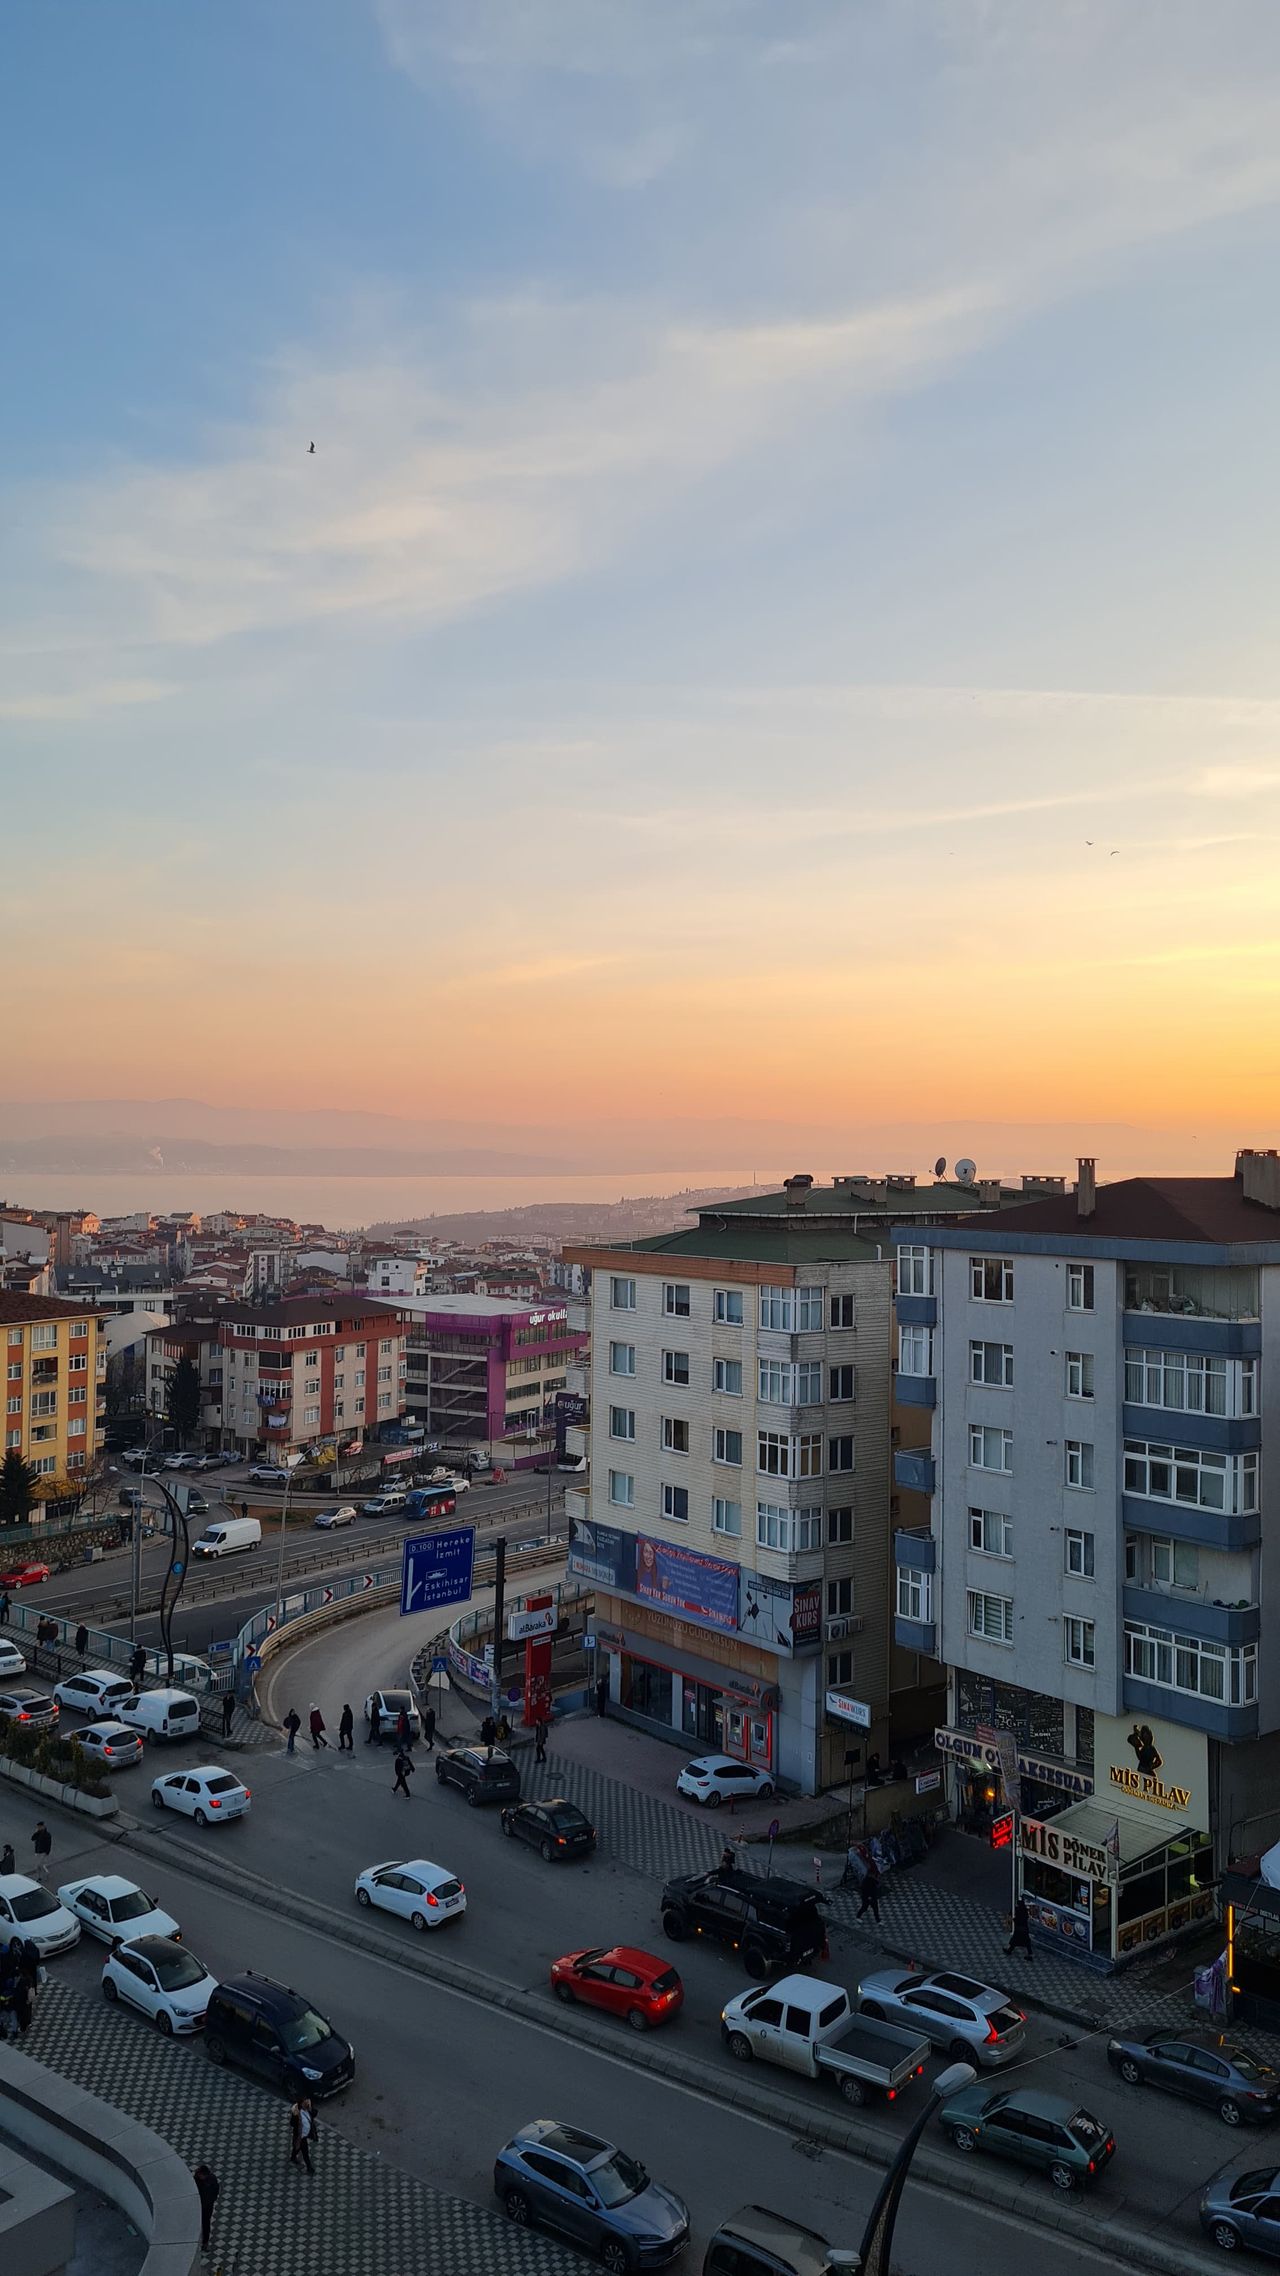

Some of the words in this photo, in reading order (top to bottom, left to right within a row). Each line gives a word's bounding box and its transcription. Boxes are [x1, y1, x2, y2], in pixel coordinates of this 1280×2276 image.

[436, 1536, 470, 1549] Hereke
[436, 1548, 460, 1559] İzmit
[424, 1576, 469, 1591] Eskihisar
[423, 1586, 462, 1602] İstanbul
[794, 1595, 820, 1613] SINAV
[796, 1610, 818, 1628] KURS
[936, 1732, 982, 1758] OLGUN
[1110, 1765, 1139, 1789] MİS
[1143, 1777, 1191, 1806] PİLAV
[1021, 1822, 1059, 1860] MİS
[1063, 1837, 1106, 1864] DÖNER
[1063, 1851, 1107, 1879] PİLAV
